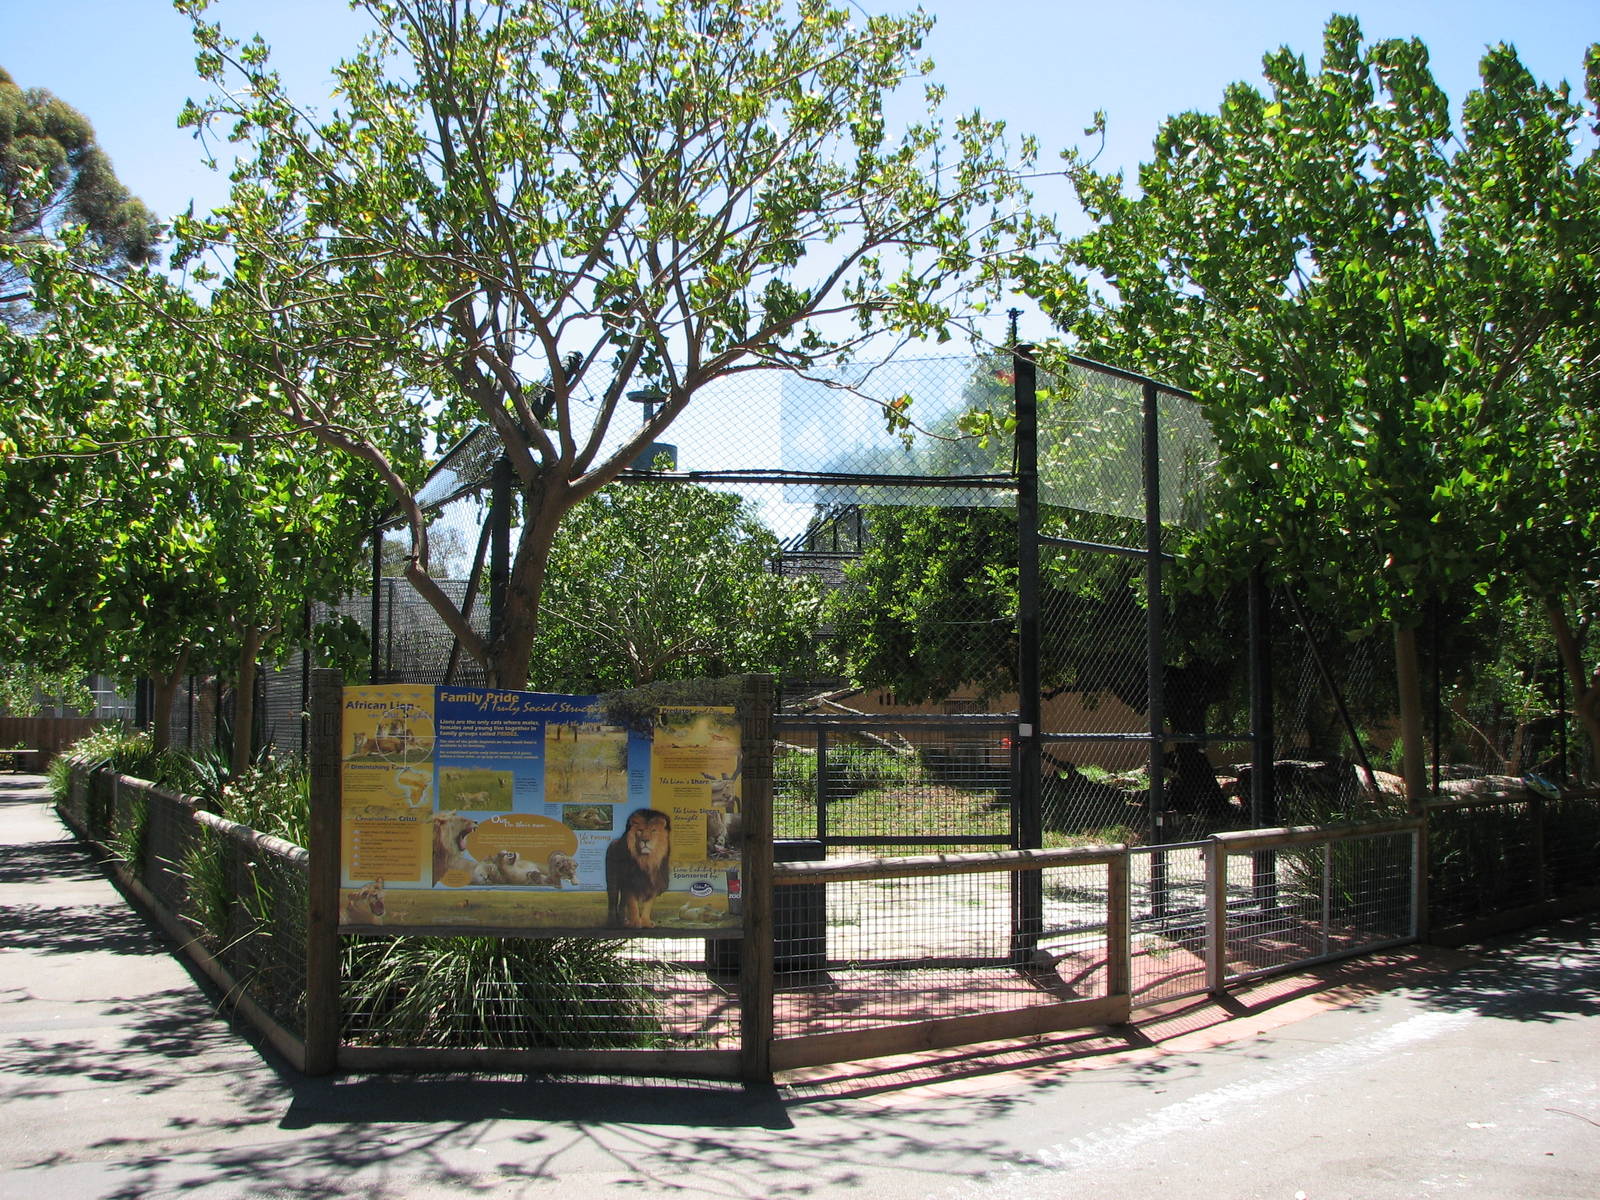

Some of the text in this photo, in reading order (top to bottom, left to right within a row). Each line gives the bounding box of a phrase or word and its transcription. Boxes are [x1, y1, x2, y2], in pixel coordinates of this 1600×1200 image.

[440, 692, 520, 704] Family Pride
[345, 700, 387, 710] African
[478, 702, 488, 711] A
[491, 701, 520, 715] Truly
[522, 702, 558, 712] Social
